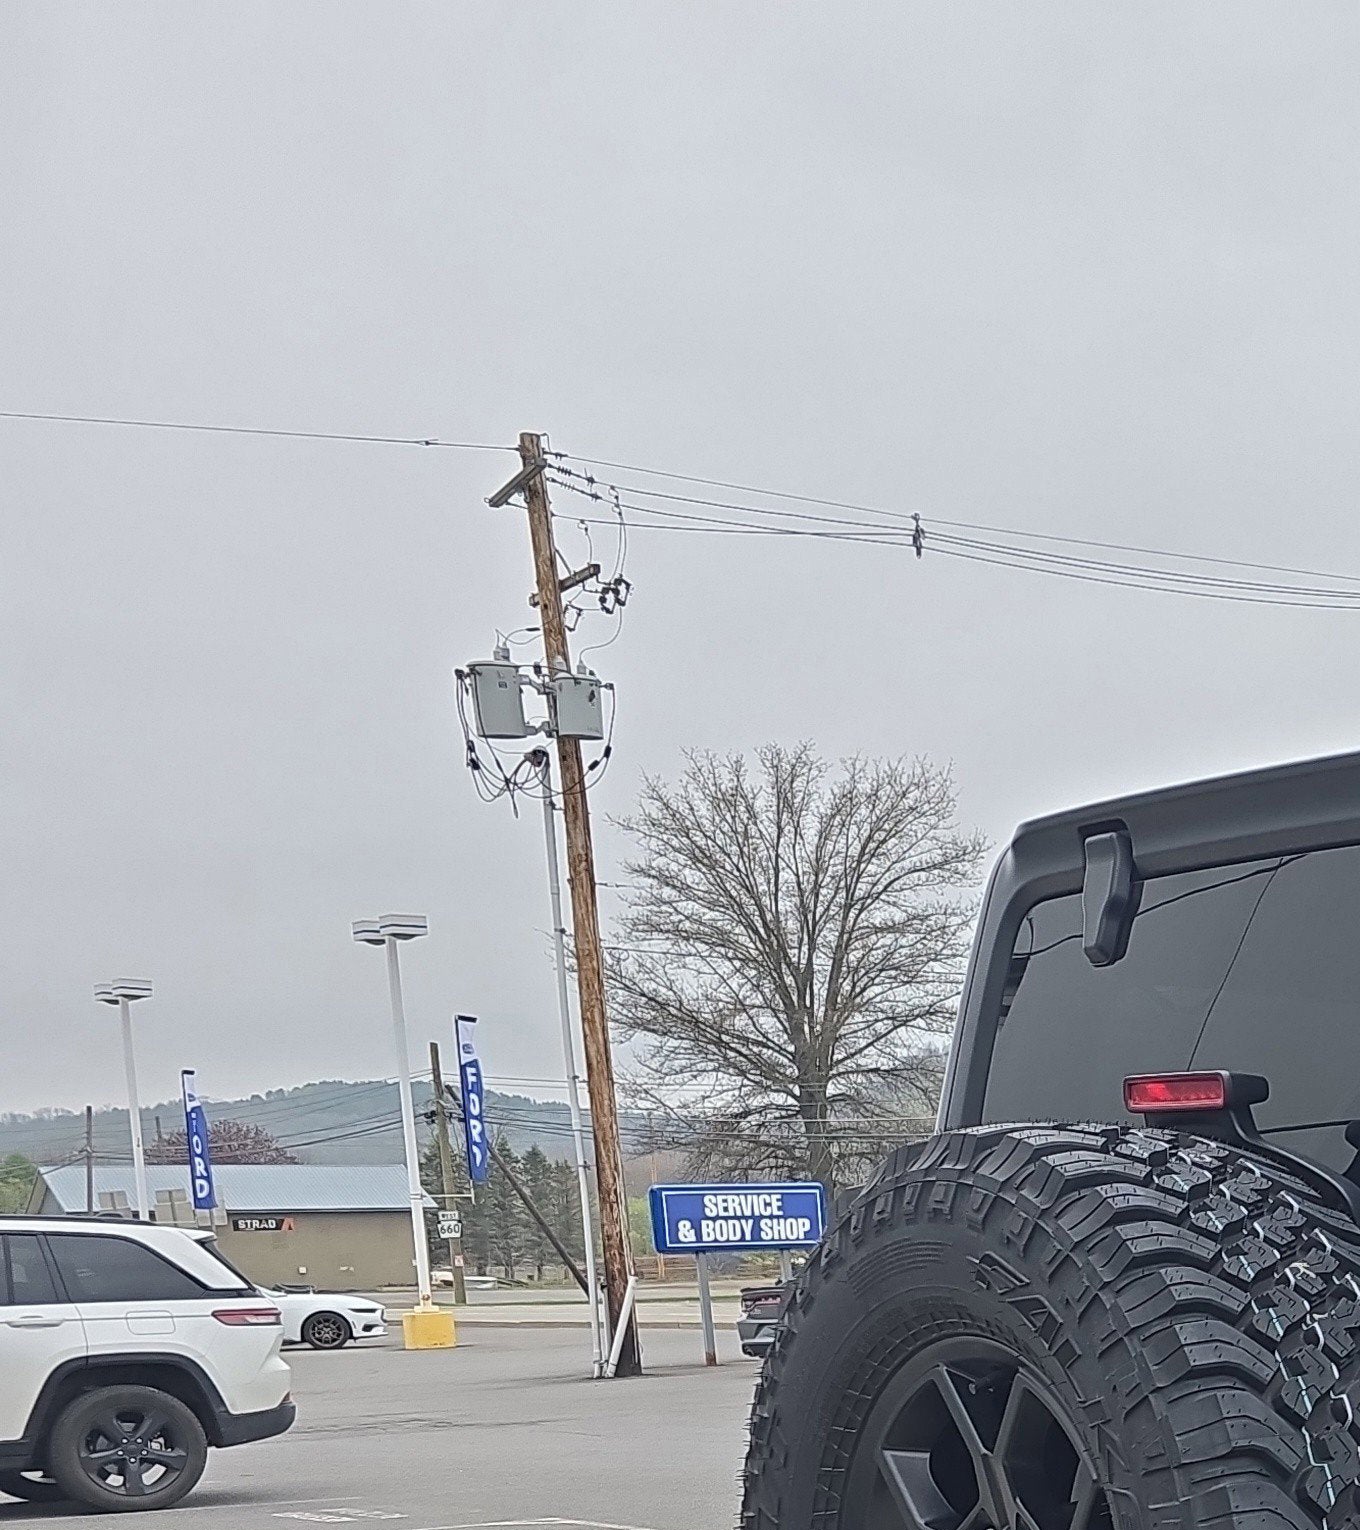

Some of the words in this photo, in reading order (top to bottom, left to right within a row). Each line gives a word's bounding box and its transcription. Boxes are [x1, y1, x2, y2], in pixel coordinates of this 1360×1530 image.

[703, 1193, 783, 1217] SERVICE
[440, 1224, 460, 1235] 660
[677, 1219, 697, 1242] &
[701, 1218, 754, 1242] BODY
[760, 1217, 811, 1241] SHOP
